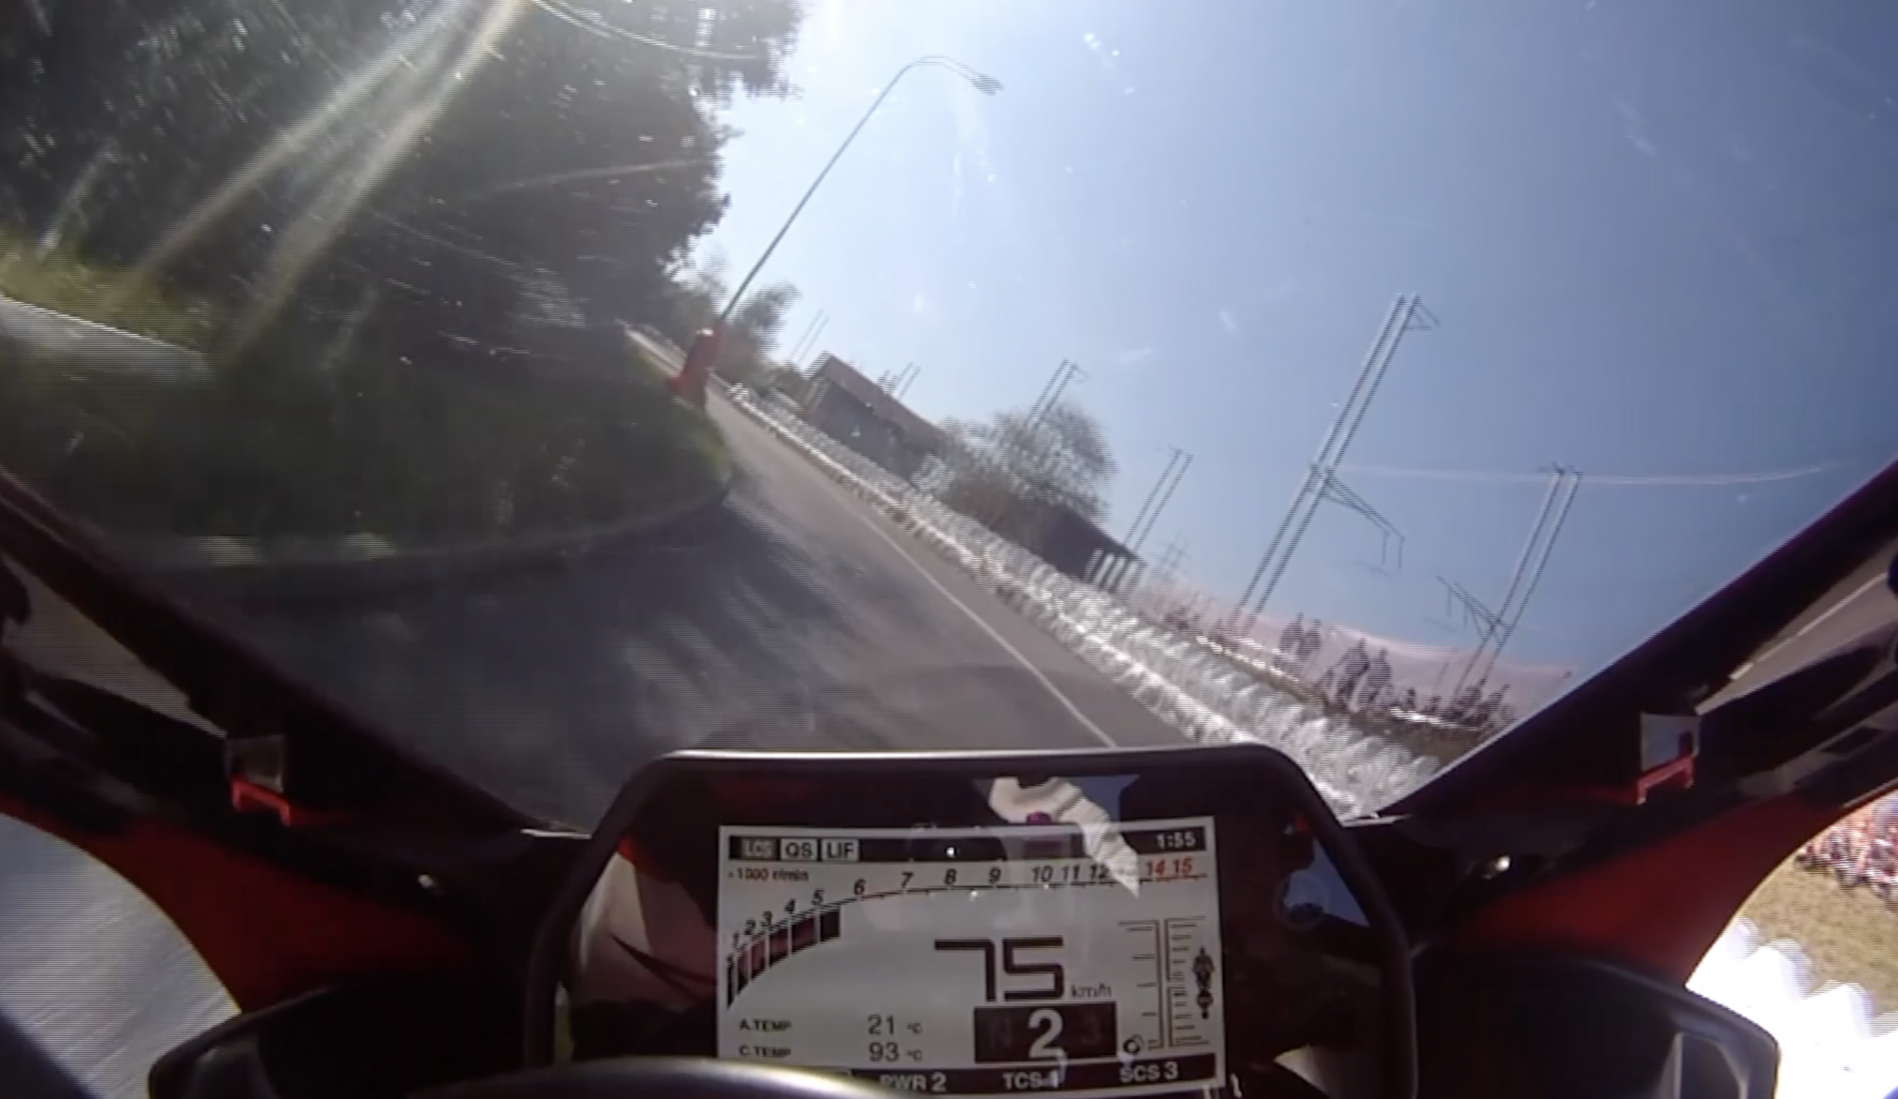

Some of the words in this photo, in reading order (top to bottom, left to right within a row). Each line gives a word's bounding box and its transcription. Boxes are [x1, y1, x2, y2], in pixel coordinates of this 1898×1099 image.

[1155, 832, 1196, 849] 1:55
[1145, 859, 1166, 877] 14
[1173, 857, 1193, 875] 15
[811, 888, 825, 906] 5
[853, 878, 867, 896] 6
[902, 871, 914, 888] 7
[944, 868, 957, 885] 8
[988, 866, 1001, 884] 9
[1032, 865, 1053, 883] 10
[1062, 864, 1080, 880] 11
[934, 936, 1064, 1002] 75
[1070, 982, 1112, 998] km/h
[867, 1014, 896, 1036] 21
[1028, 1008, 1064, 1060] 2
[868, 1041, 900, 1063] 93
[931, 1072, 948, 1093] 2
[1002, 1072, 1041, 1090] TCS
[1119, 1064, 1161, 1083] SCS
[1164, 1061, 1180, 1081] 3
